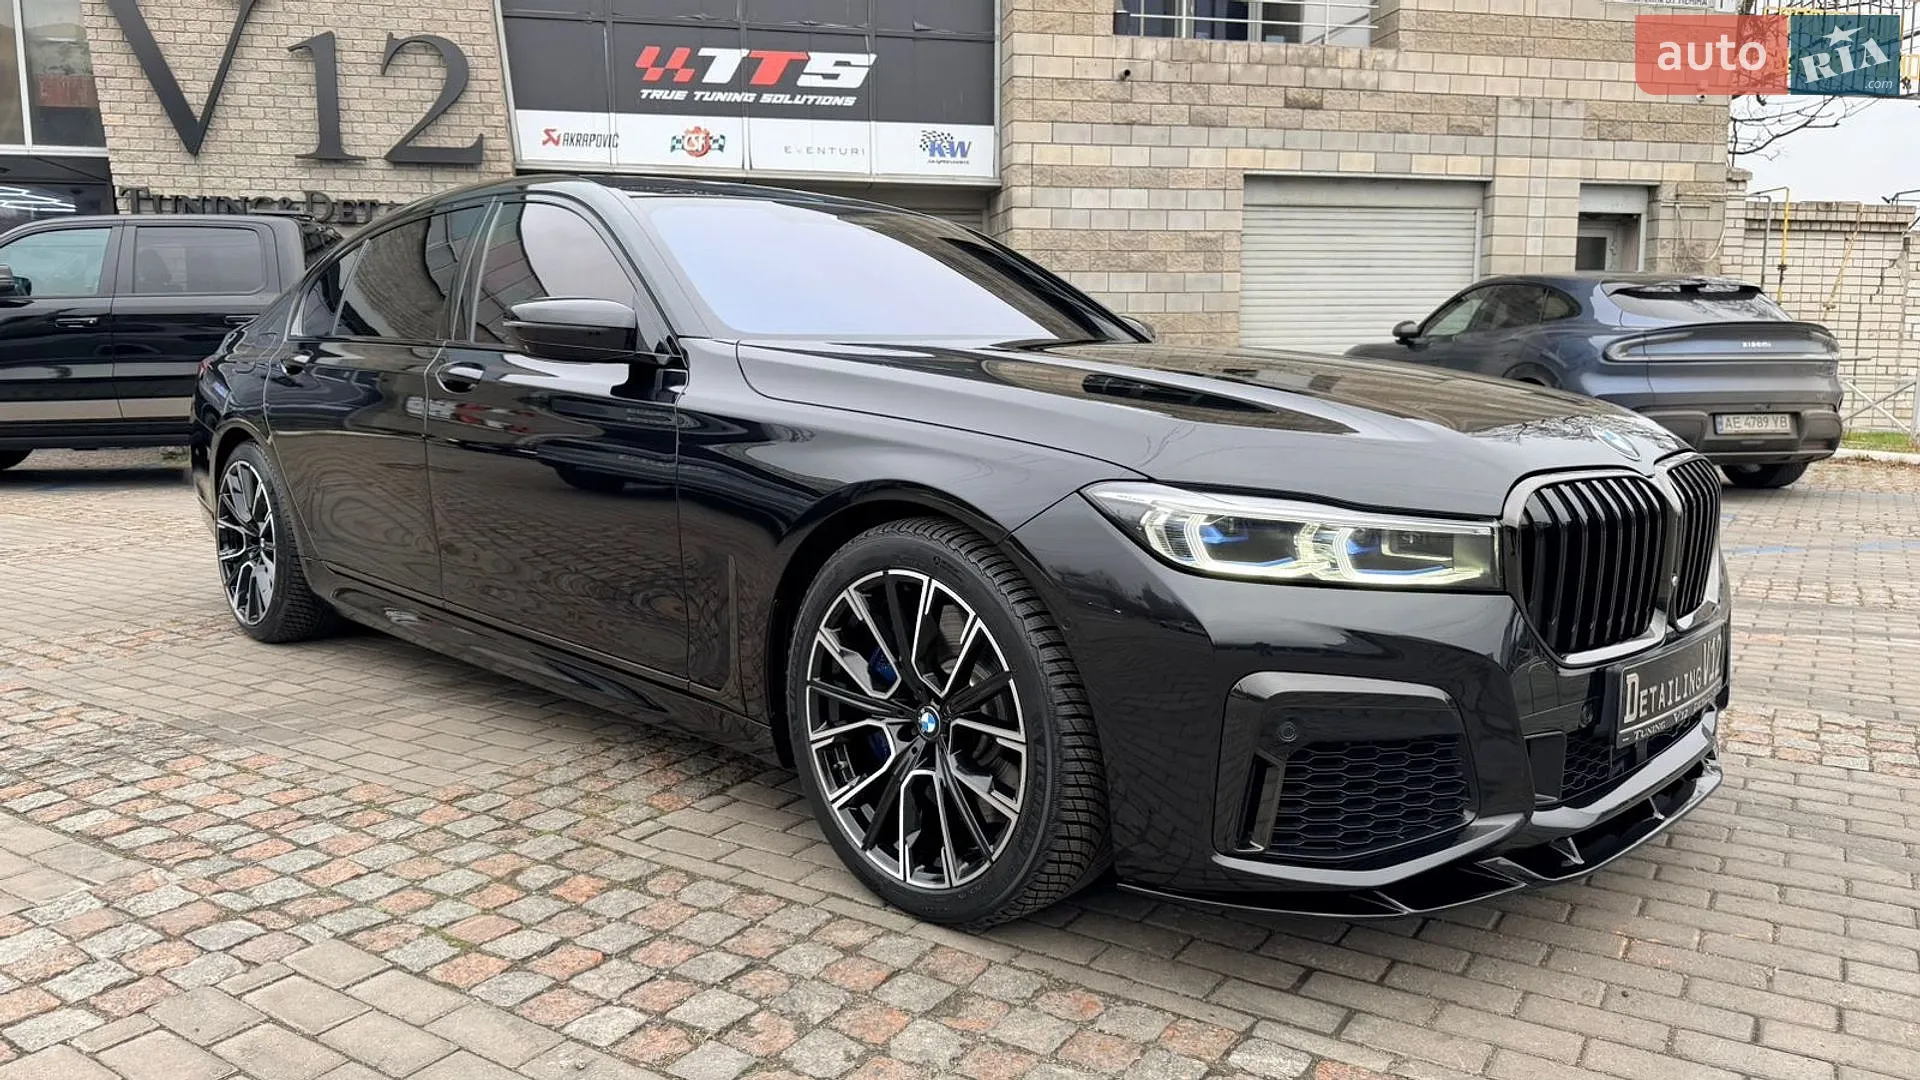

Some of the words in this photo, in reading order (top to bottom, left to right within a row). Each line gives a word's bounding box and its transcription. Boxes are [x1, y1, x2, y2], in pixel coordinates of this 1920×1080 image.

[109, 0, 484, 164] V12
[640, 88, 688, 101] TRUE
[693, 91, 758, 103] TUNING
[759, 93, 857, 106] SOLUTIONS
[783, 145, 865, 156] EVENTURI
[1725, 416, 1741, 429] AE
[1744, 415, 1769, 429] 4789
[1624, 667, 1702, 723] DETAILING
[1703, 634, 1722, 686] V12
